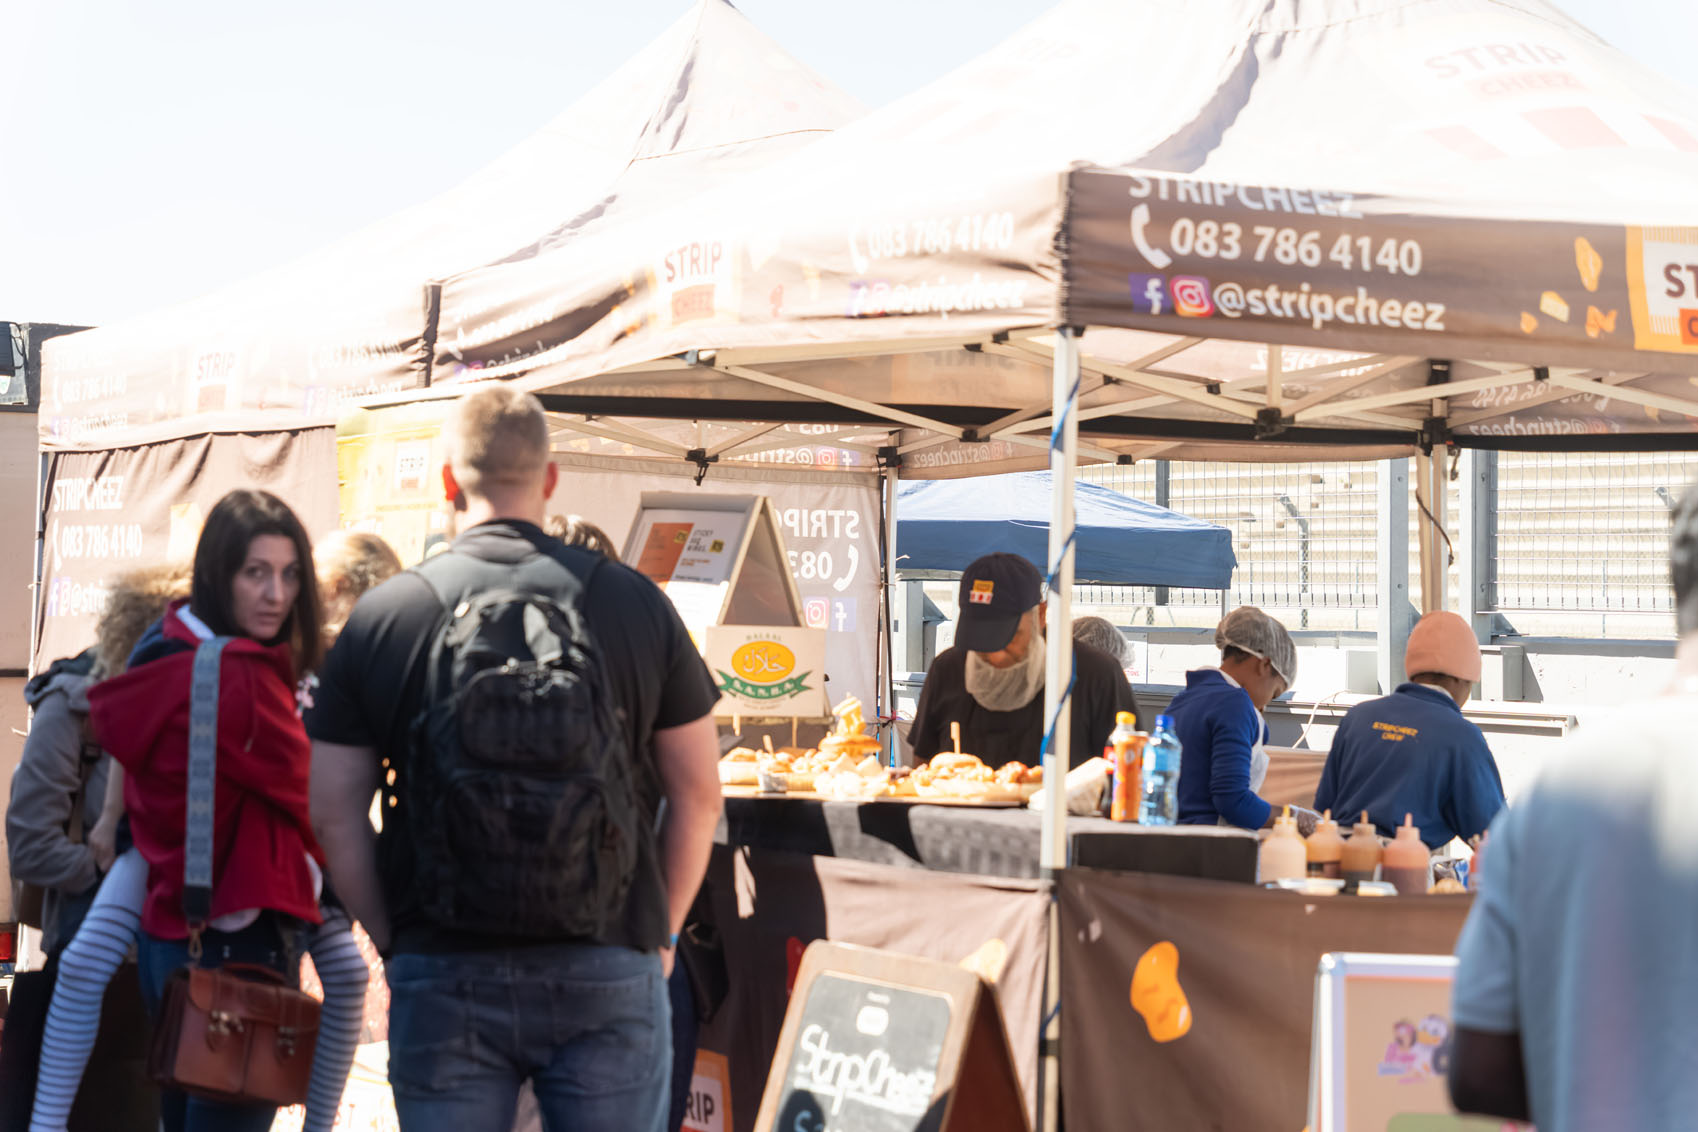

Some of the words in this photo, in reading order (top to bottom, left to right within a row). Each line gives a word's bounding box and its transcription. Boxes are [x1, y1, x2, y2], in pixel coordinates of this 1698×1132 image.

[1424, 42, 1567, 79] STRIP
[1129, 174, 1363, 219] STRIPCHEEZ
[869, 222, 907, 259] 083
[956, 211, 1015, 251] 4140
[1170, 218, 1242, 260] 083
[1253, 225, 1321, 267] 786
[1329, 234, 1422, 276] 4140
[664, 241, 723, 284] STRIP
[1213, 282, 1446, 331] @stripcheez
[61, 525, 84, 559] 083
[85, 524, 109, 558] 786
[110, 523, 143, 558] 4140
